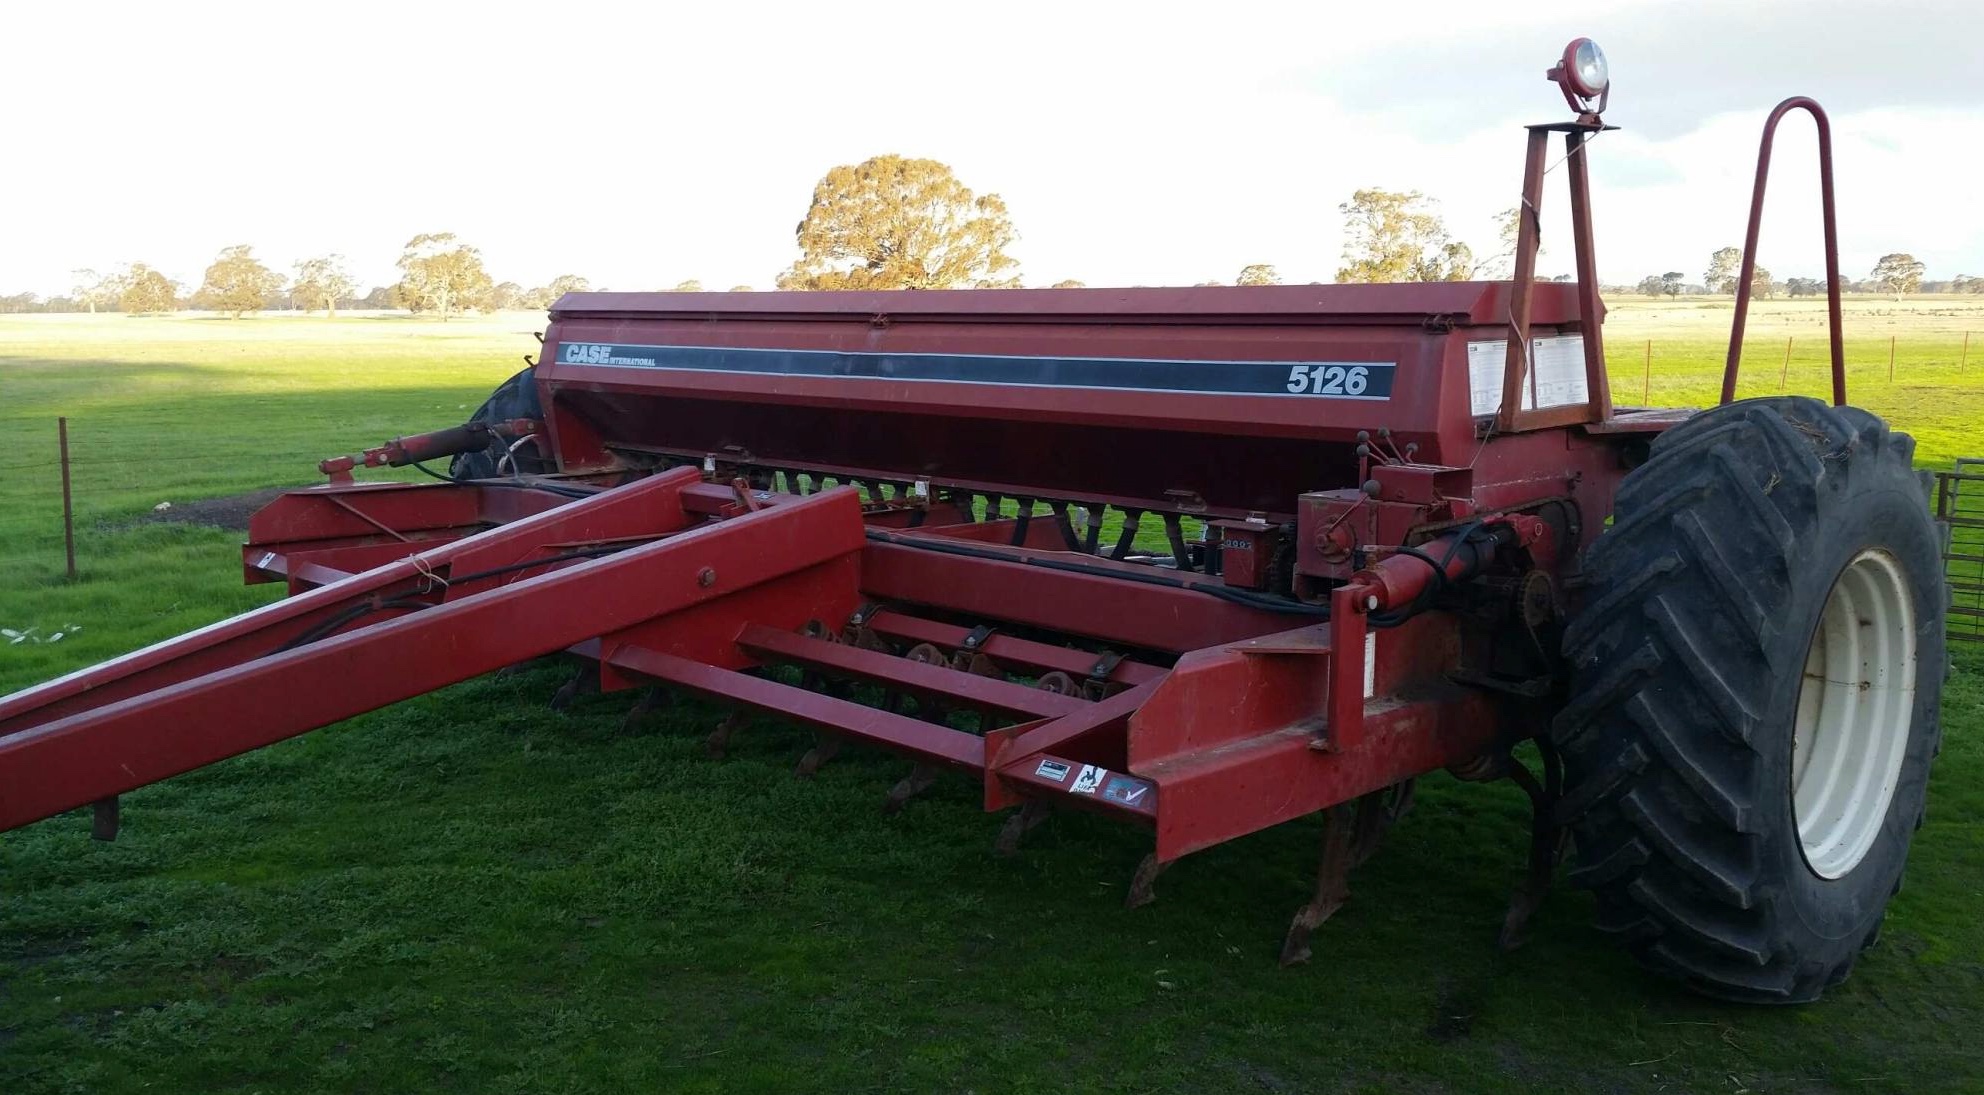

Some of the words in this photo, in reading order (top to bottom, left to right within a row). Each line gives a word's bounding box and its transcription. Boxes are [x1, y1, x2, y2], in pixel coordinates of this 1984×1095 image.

[566, 344, 612, 364] CASE
[609, 357, 656, 366] INTERNATIONAL
[1286, 365, 1369, 396] 5126
